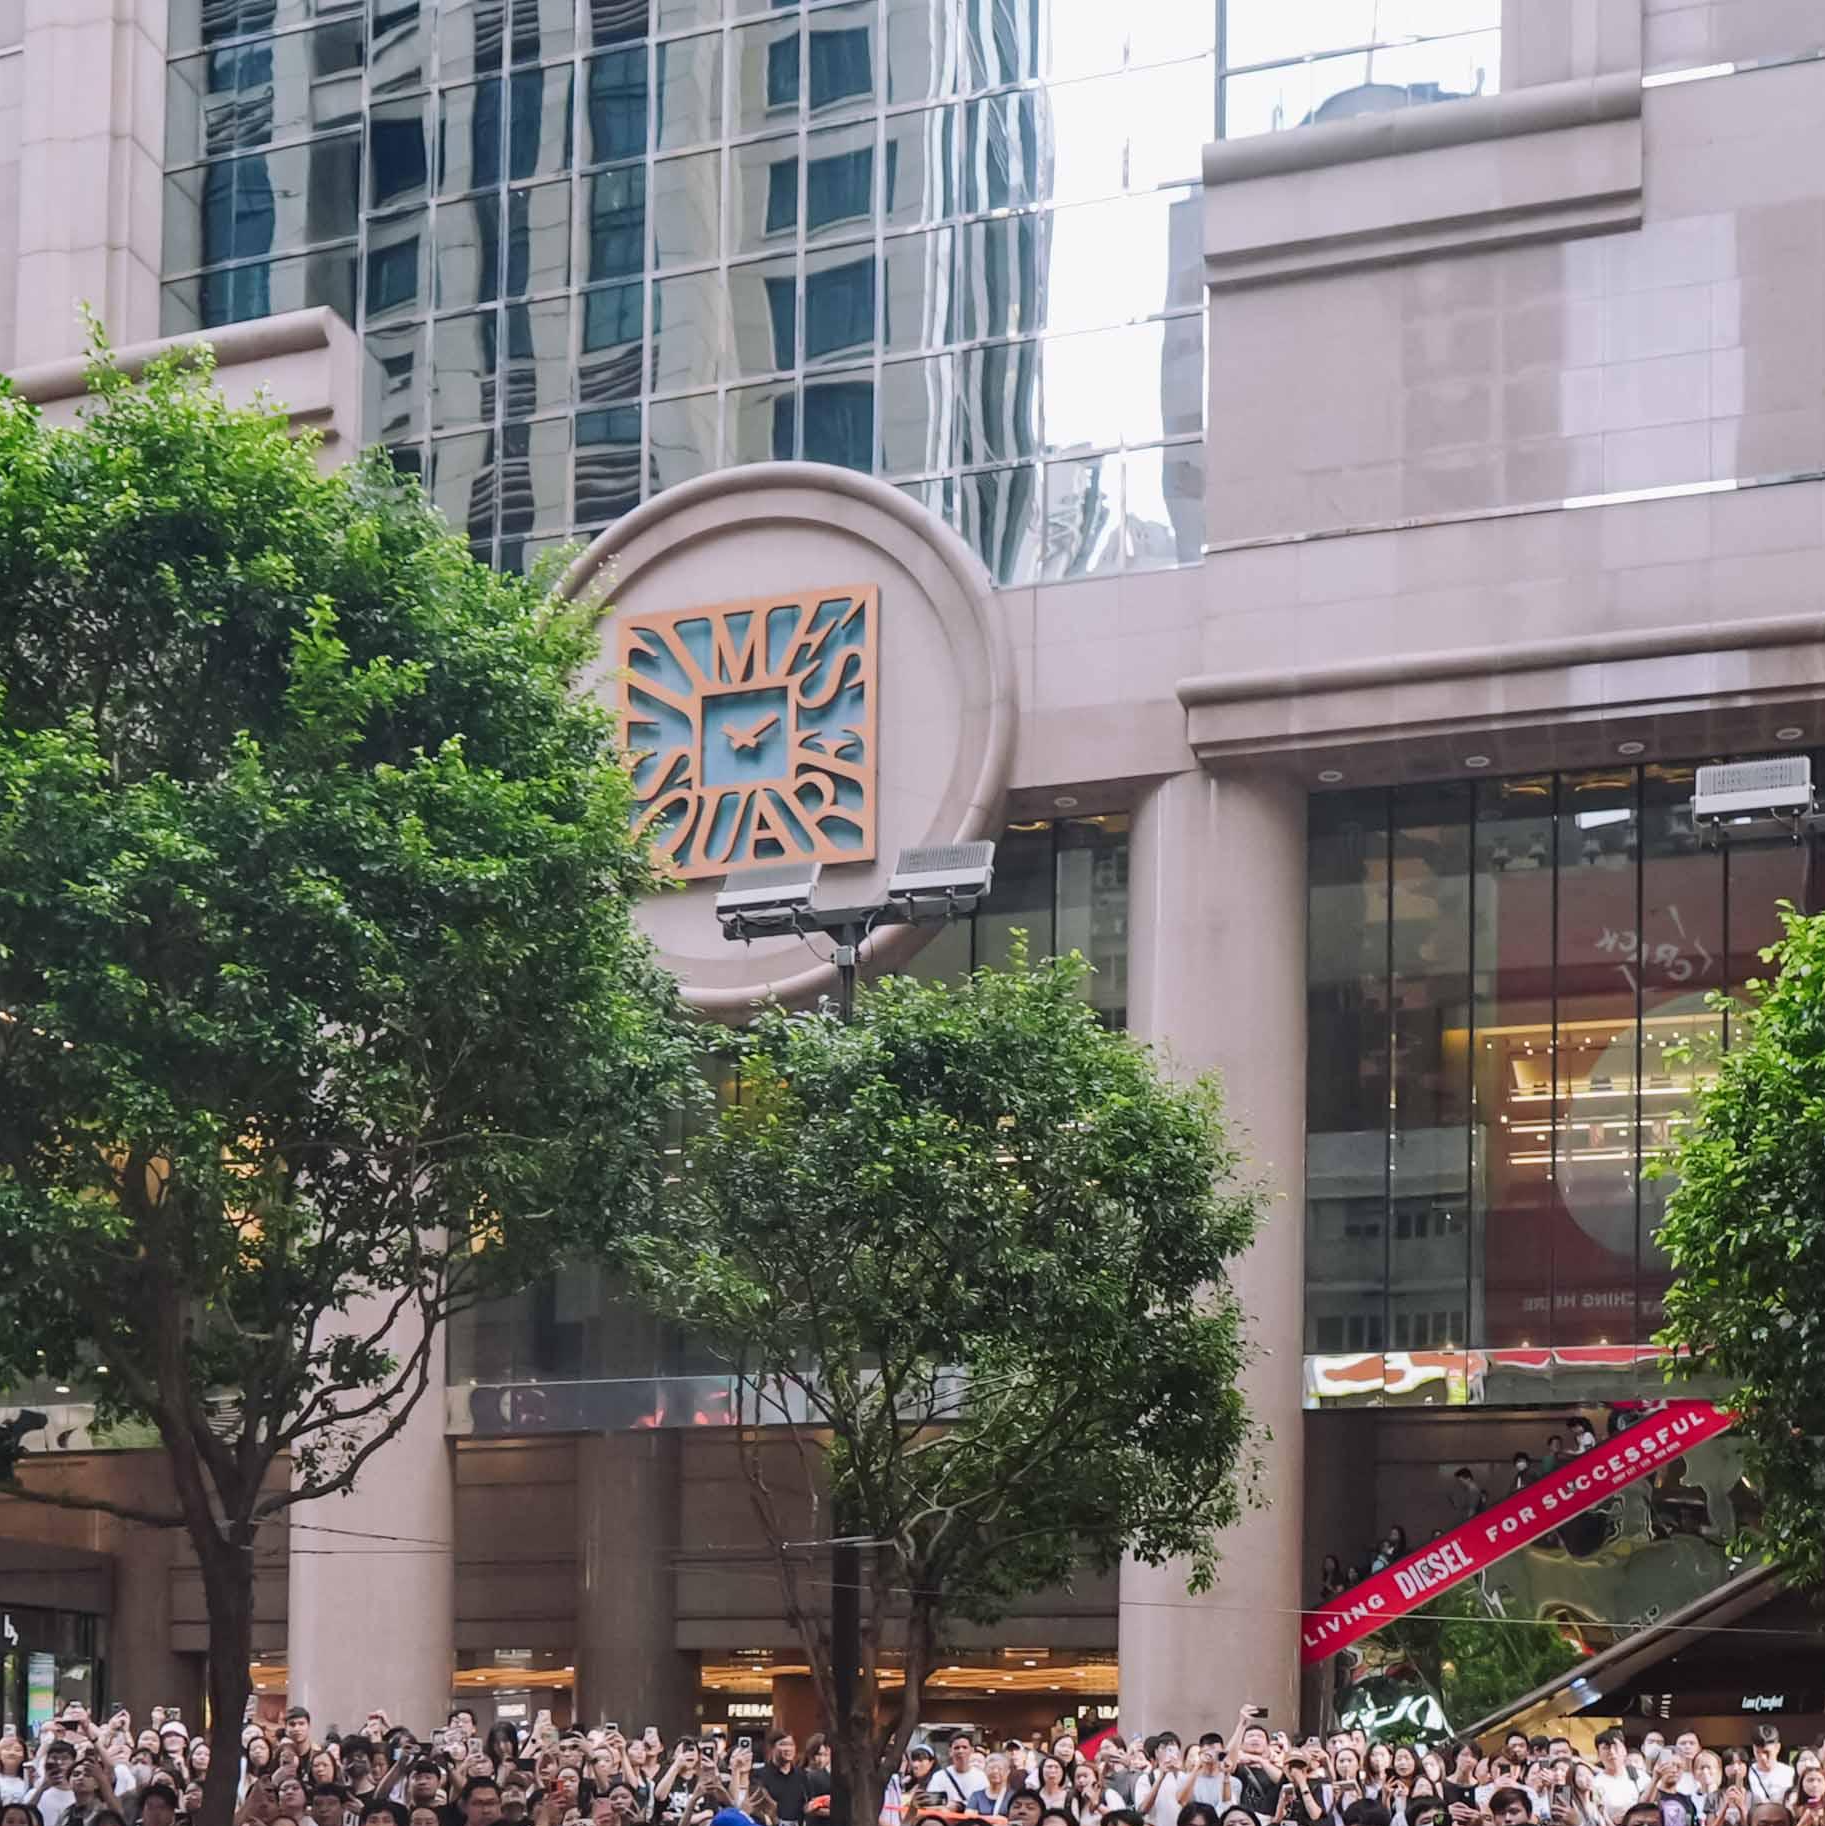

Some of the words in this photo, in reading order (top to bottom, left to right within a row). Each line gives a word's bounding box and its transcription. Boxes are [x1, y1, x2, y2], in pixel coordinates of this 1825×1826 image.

[1304, 1593, 1386, 1648] LIVING
[1394, 1541, 1474, 1601] DIESEL
[1485, 1506, 1537, 1543] FOR
[1541, 1409, 1706, 1512] SUCCESSFUL
